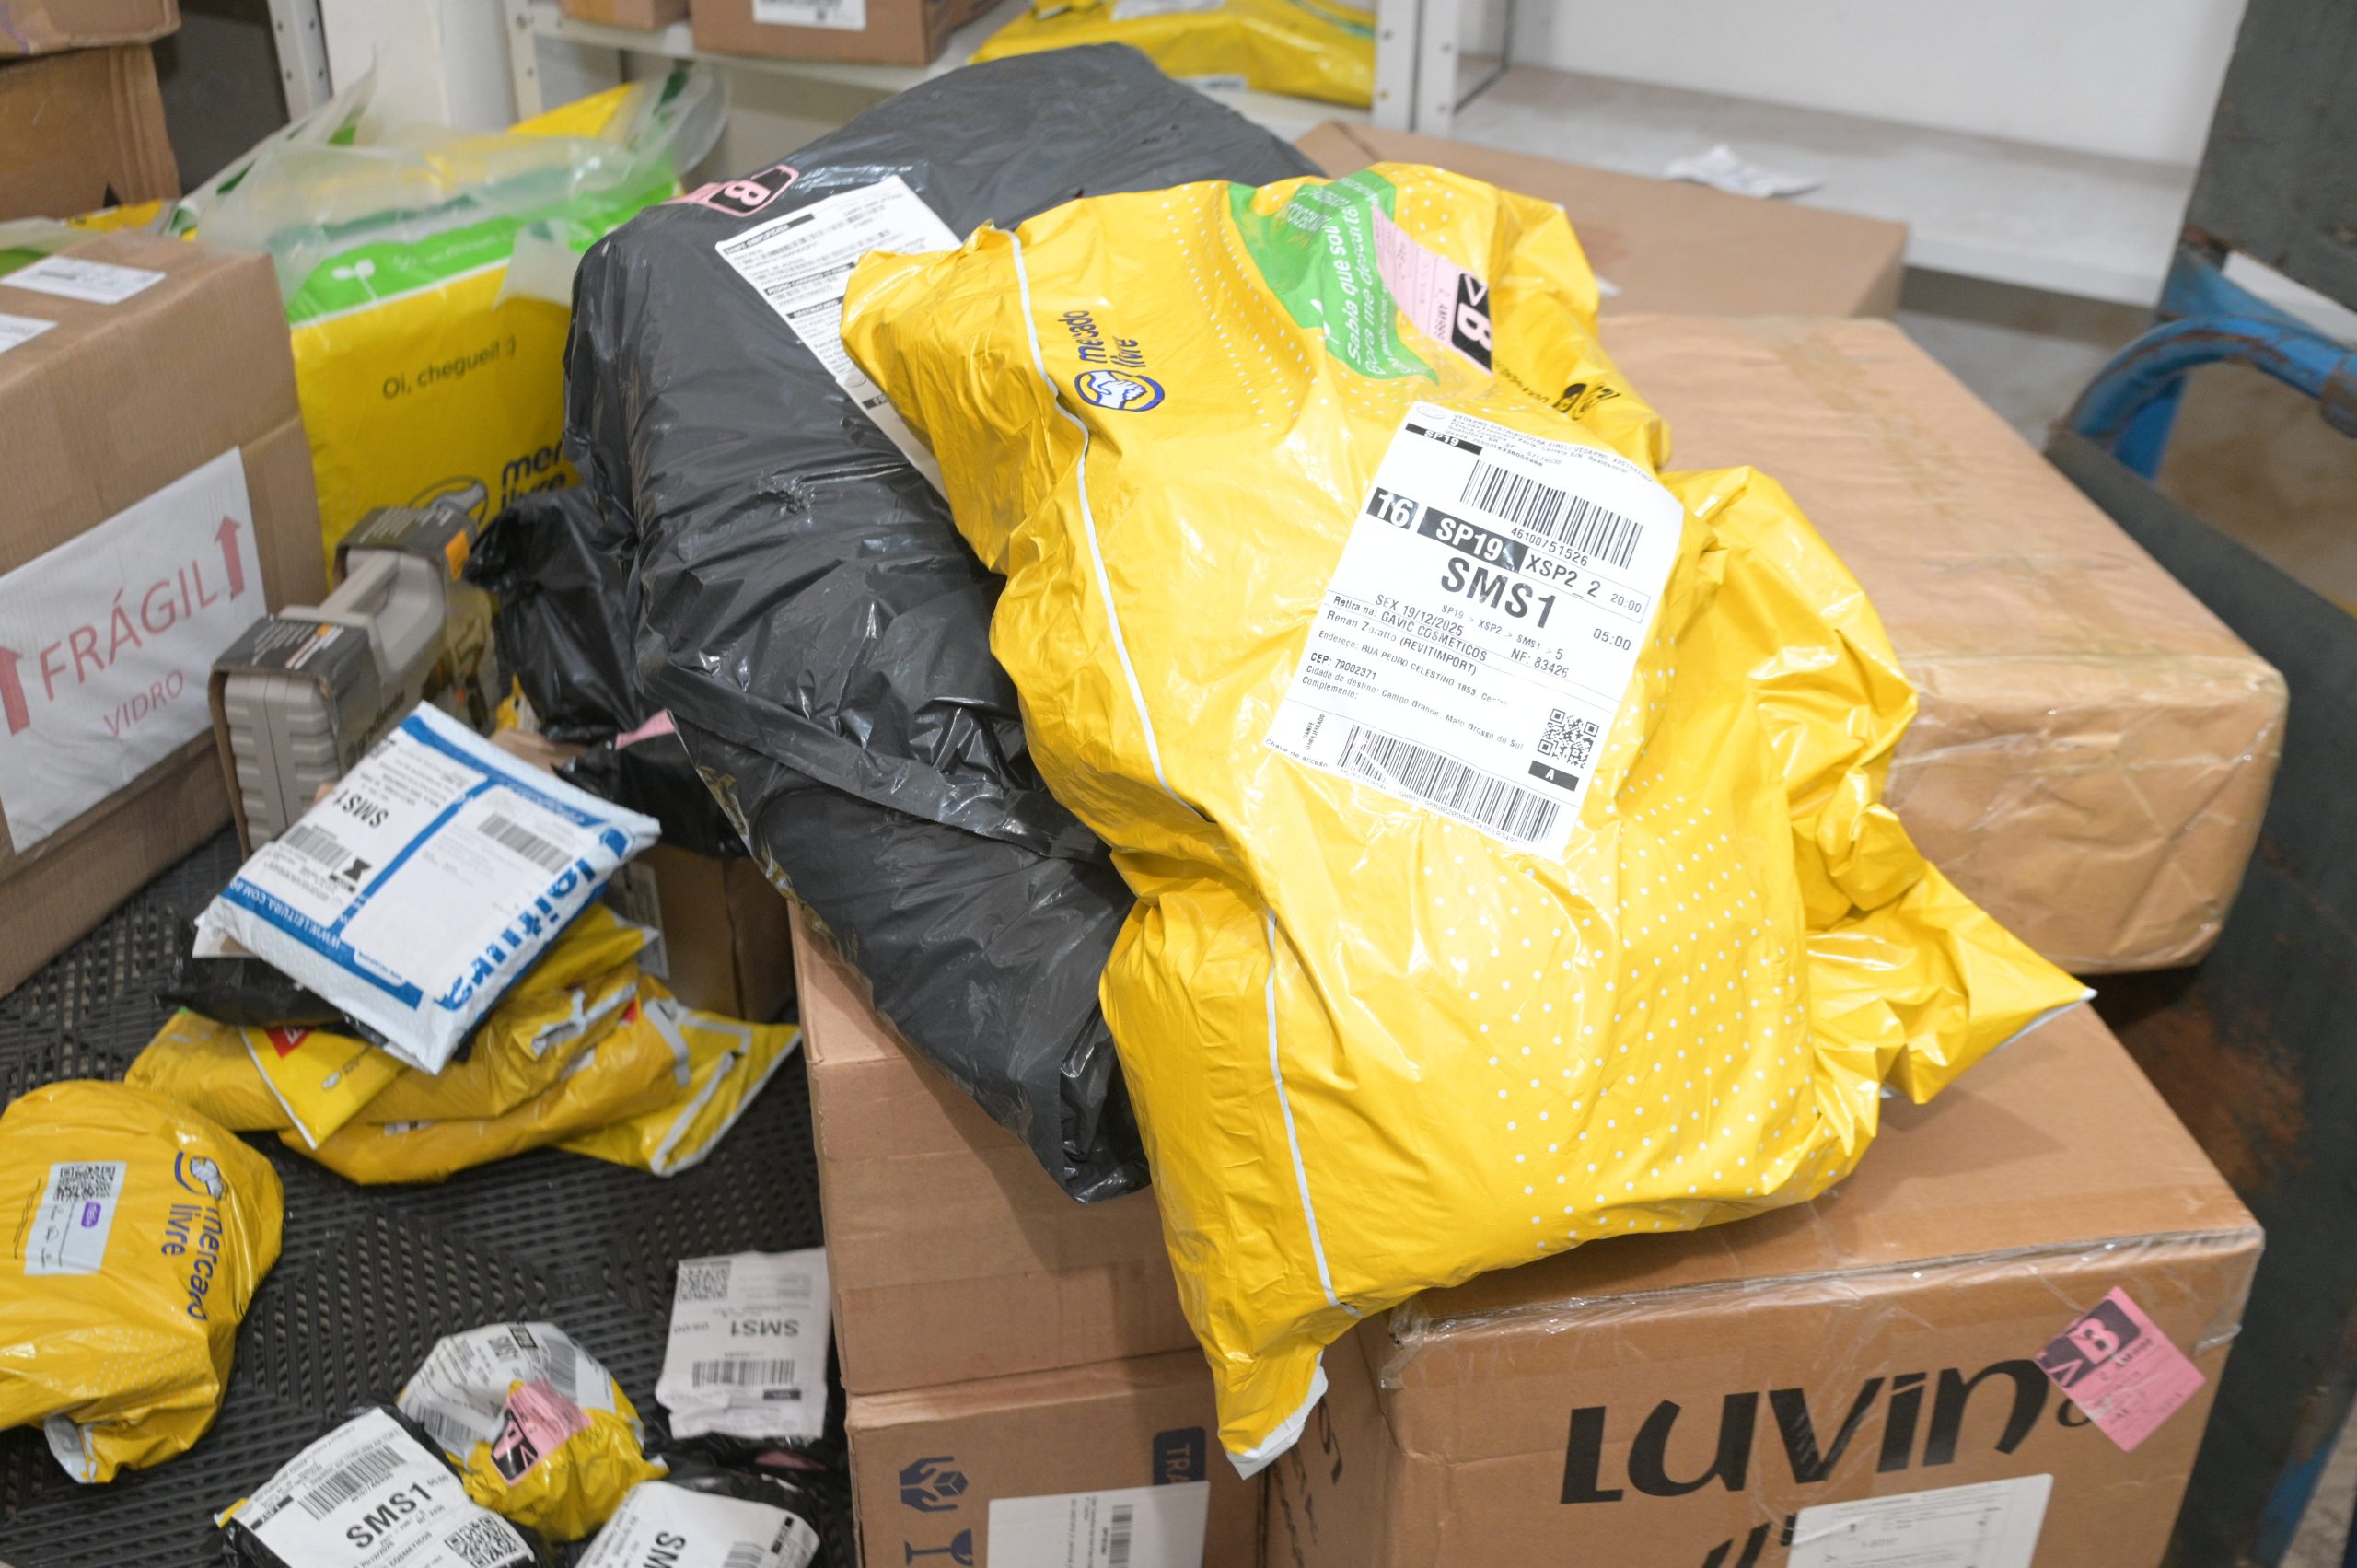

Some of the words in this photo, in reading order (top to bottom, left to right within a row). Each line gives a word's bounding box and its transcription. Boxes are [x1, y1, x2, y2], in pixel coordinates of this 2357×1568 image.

[1323, 226, 1347, 256] sou
[1339, 258, 1357, 294] que
[1057, 310, 1108, 363] mercado
[1109, 339, 1146, 367] livre
[1345, 296, 1363, 365] Sabia
[381, 374, 412, 400] Oi,
[1423, 429, 1460, 447] SP19
[1377, 494, 1415, 527] 16
[1435, 517, 1504, 562] SP19
[1611, 593, 1642, 613] 20:00
[1511, 527, 1587, 566] 46100751526
[1376, 594, 1399, 610] SEX
[1403, 606, 1464, 636] 19/12/2025
[1441, 556, 1556, 628] SMS1
[39, 559, 218, 702] FRÁGIL
[1327, 610, 1358, 627] Renan
[1399, 637, 1477, 676] (REVITIMPORT)
[1334, 596, 1360, 611] Retira
[1381, 611, 1415, 632] GAVIC
[1417, 626, 1488, 661] COSMETICOS
[1442, 604, 1464, 619] SP19
[1478, 621, 1502, 634] XSP2
[1516, 635, 1541, 650] SMS1
[1555, 648, 1563, 660] 5
[1593, 628, 1631, 650] 05:00
[1310, 652, 1332, 667] CEP:
[1335, 659, 1376, 680] 79002371
[1318, 630, 1358, 649] Endereço:
[1361, 645, 1378, 656] RUA
[1381, 651, 1409, 667] PEDRO
[1411, 663, 1455, 686] CELESTINO
[1511, 648, 1531, 664] NF:
[1534, 657, 1569, 678] 83426
[103, 670, 185, 738] VIDRO
[1302, 677, 1359, 700] Complemento:
[1306, 666, 1332, 679] Cidade
[1335, 673, 1344, 682] de
[1382, 690, 1409, 704] Campo
[1446, 714, 1465, 726] Mato
[1468, 724, 1494, 740] Grosso
[1496, 735, 1507, 744] do
[1510, 739, 1524, 750] Sul
[1545, 769, 1554, 781] A
[332, 787, 389, 830] SMS1
[433, 858, 597, 1012] leitura
[161, 1202, 202, 1256] livre
[729, 1318, 800, 1338] SMS1
[1560, 1359, 2052, 1504] Luvin
[346, 1481, 433, 1549] SMS1
